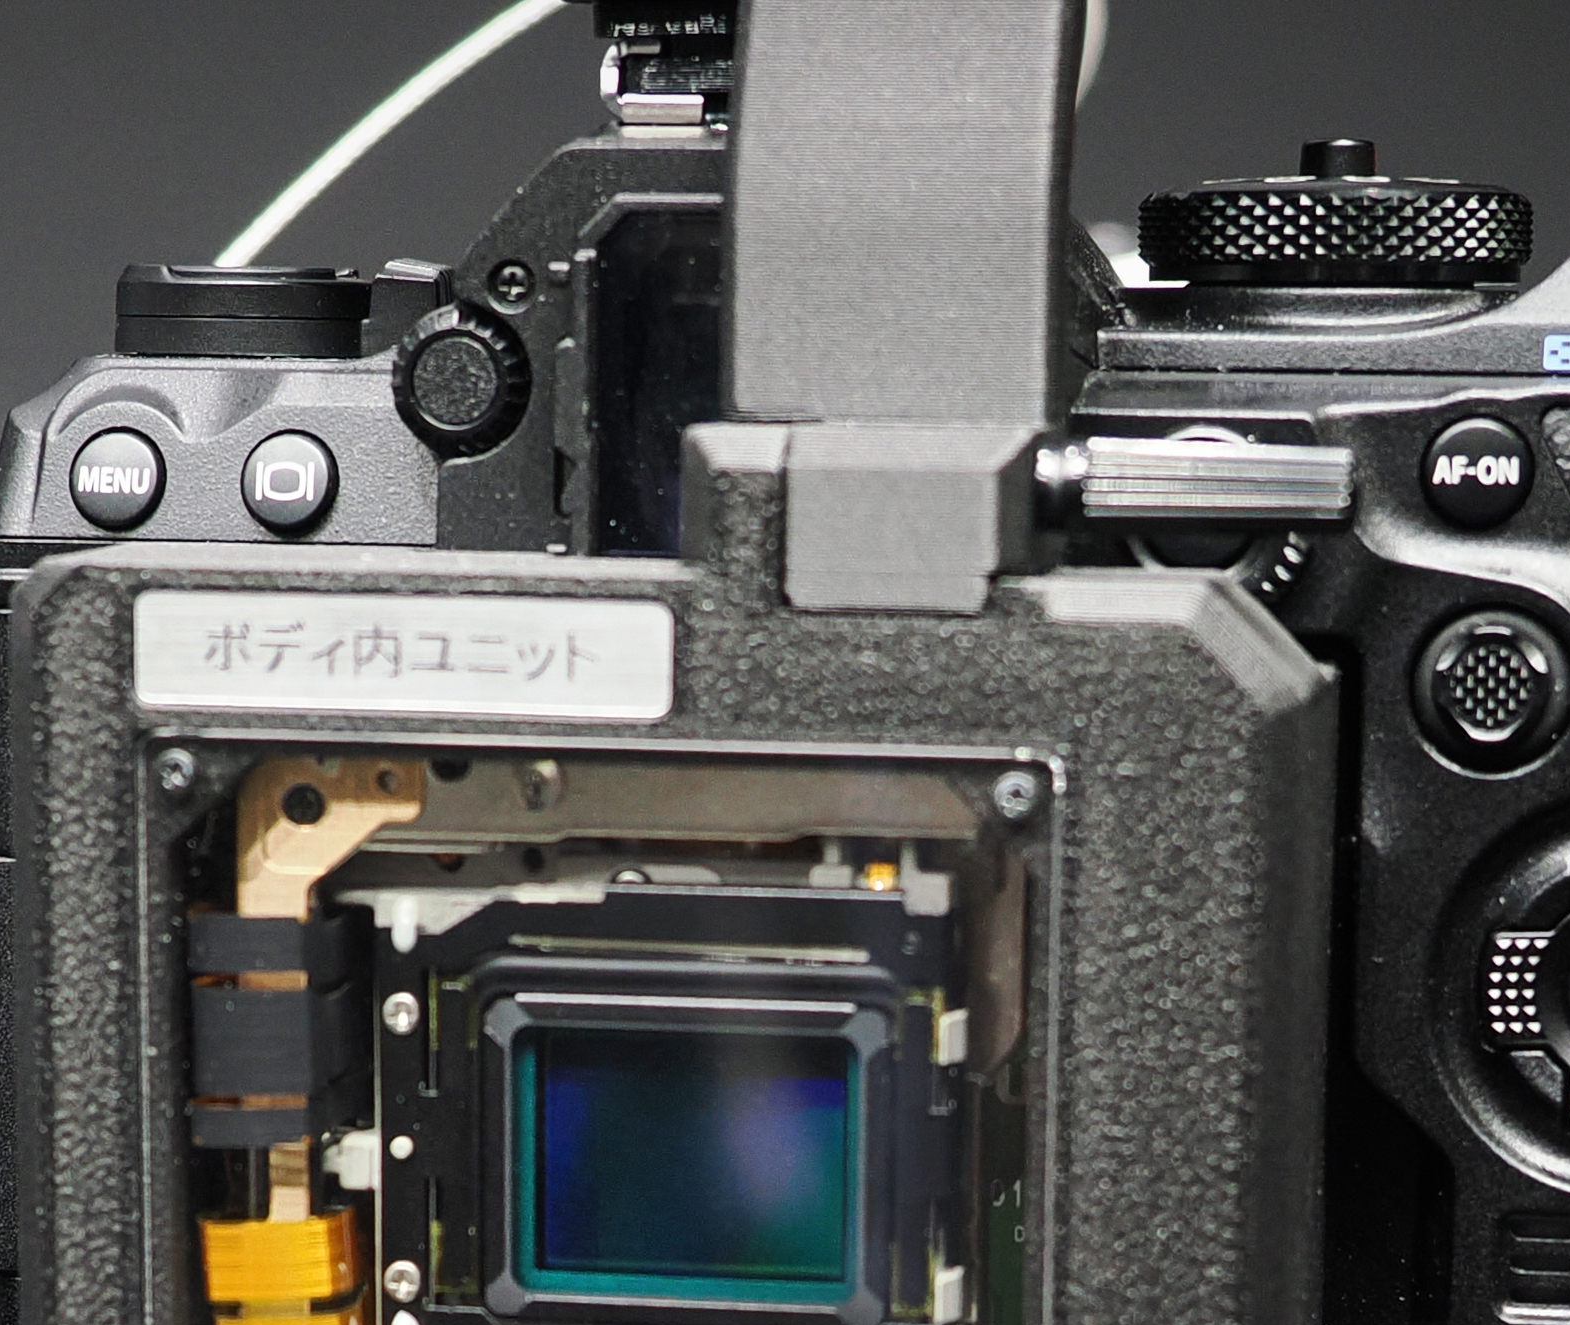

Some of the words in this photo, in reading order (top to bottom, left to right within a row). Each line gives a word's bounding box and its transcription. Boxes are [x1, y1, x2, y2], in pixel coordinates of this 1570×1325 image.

[76, 464, 152, 496] MENU
[1431, 454, 1522, 487] AF-ON
[202, 620, 601, 682] ボディ内ユニット
